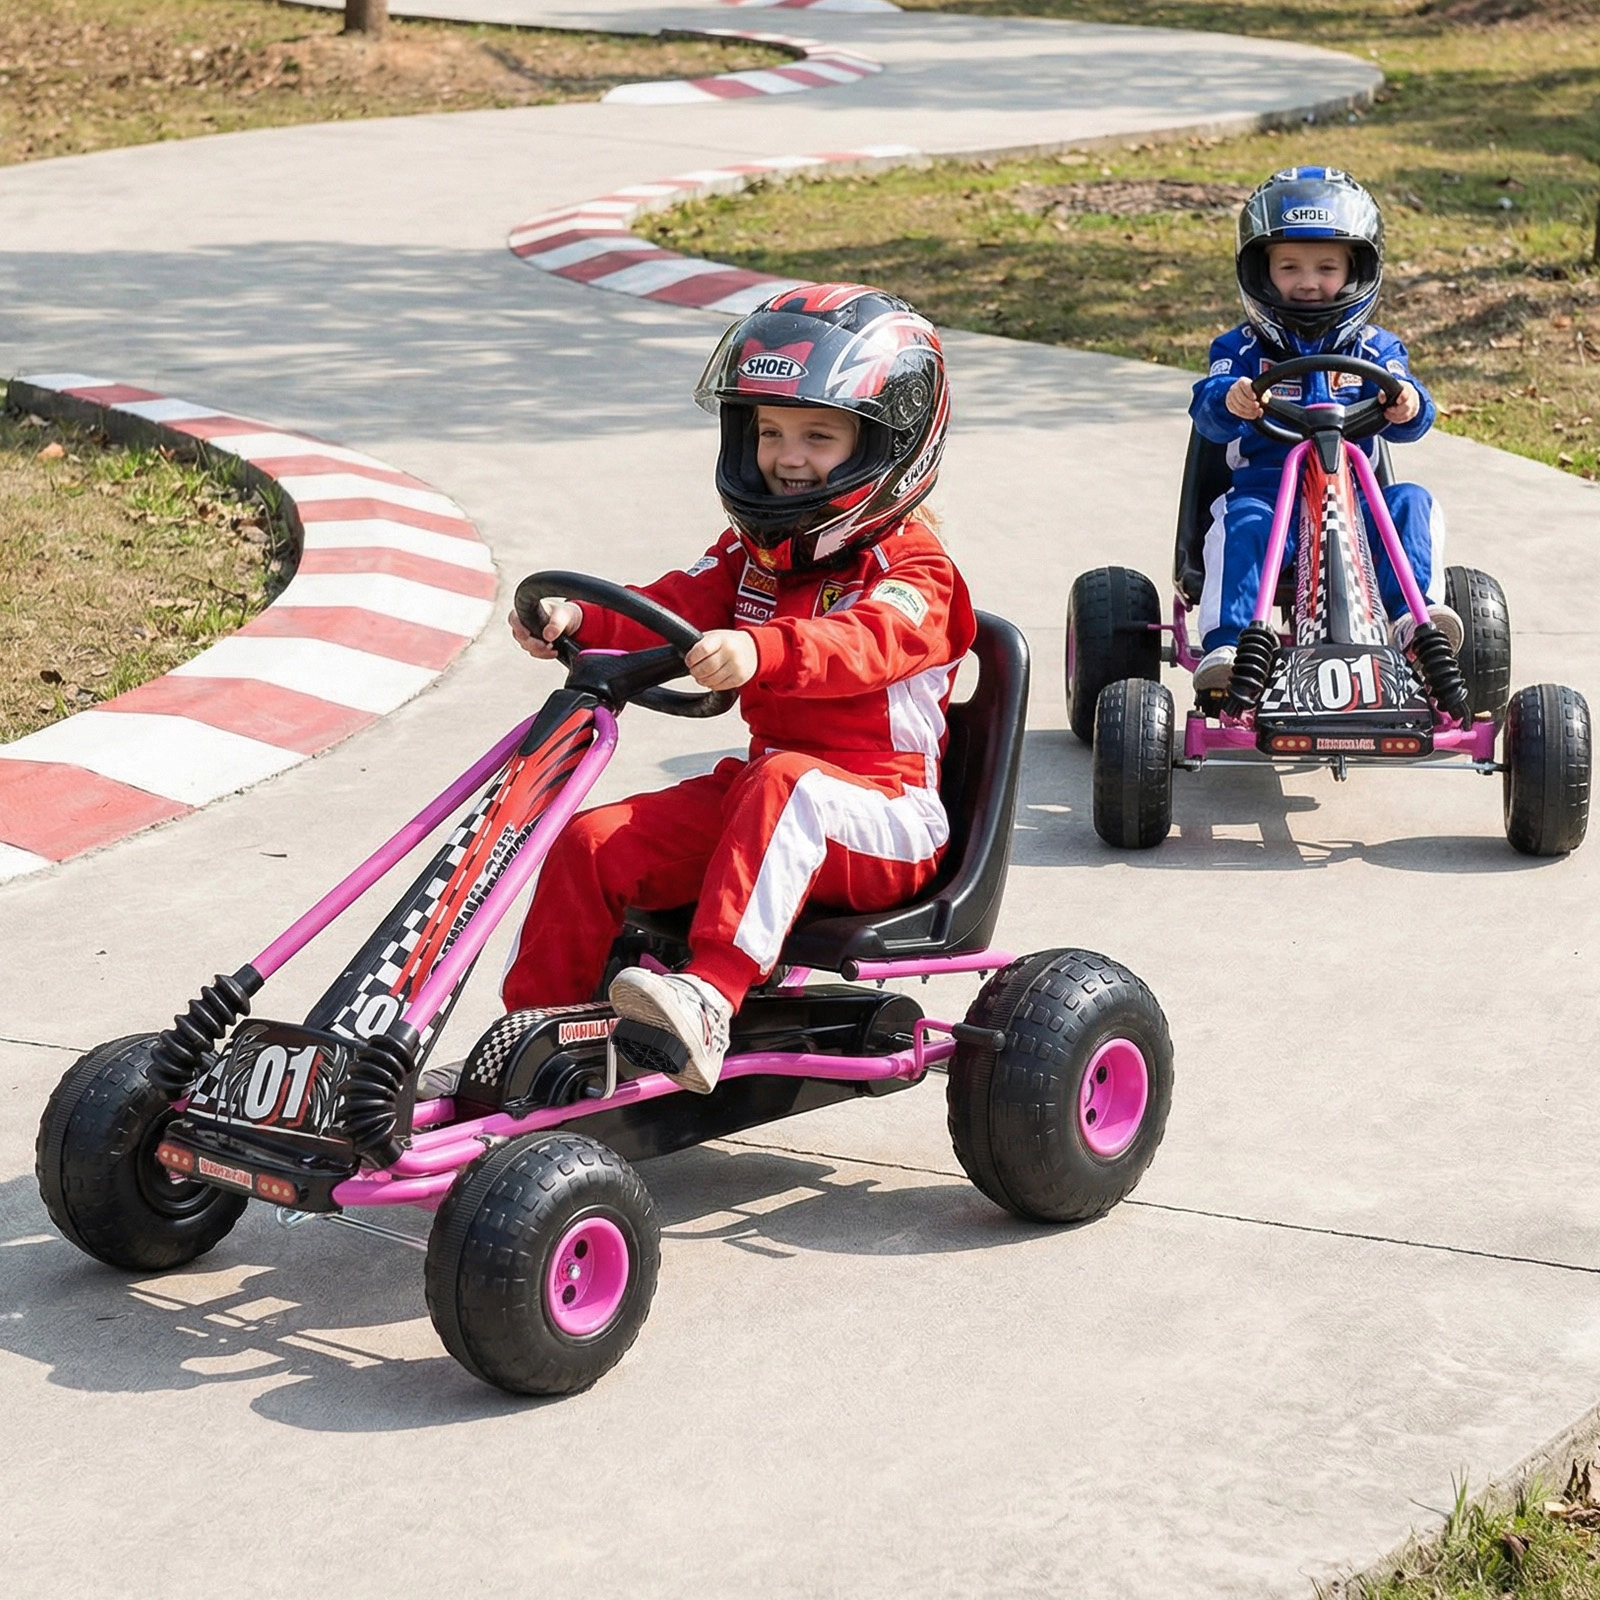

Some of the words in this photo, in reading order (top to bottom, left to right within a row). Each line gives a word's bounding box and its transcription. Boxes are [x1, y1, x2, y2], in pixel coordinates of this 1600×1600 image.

[747, 358, 794, 377] SHOEI
[1317, 653, 1377, 710] 01
[244, 1045, 318, 1119] 01
